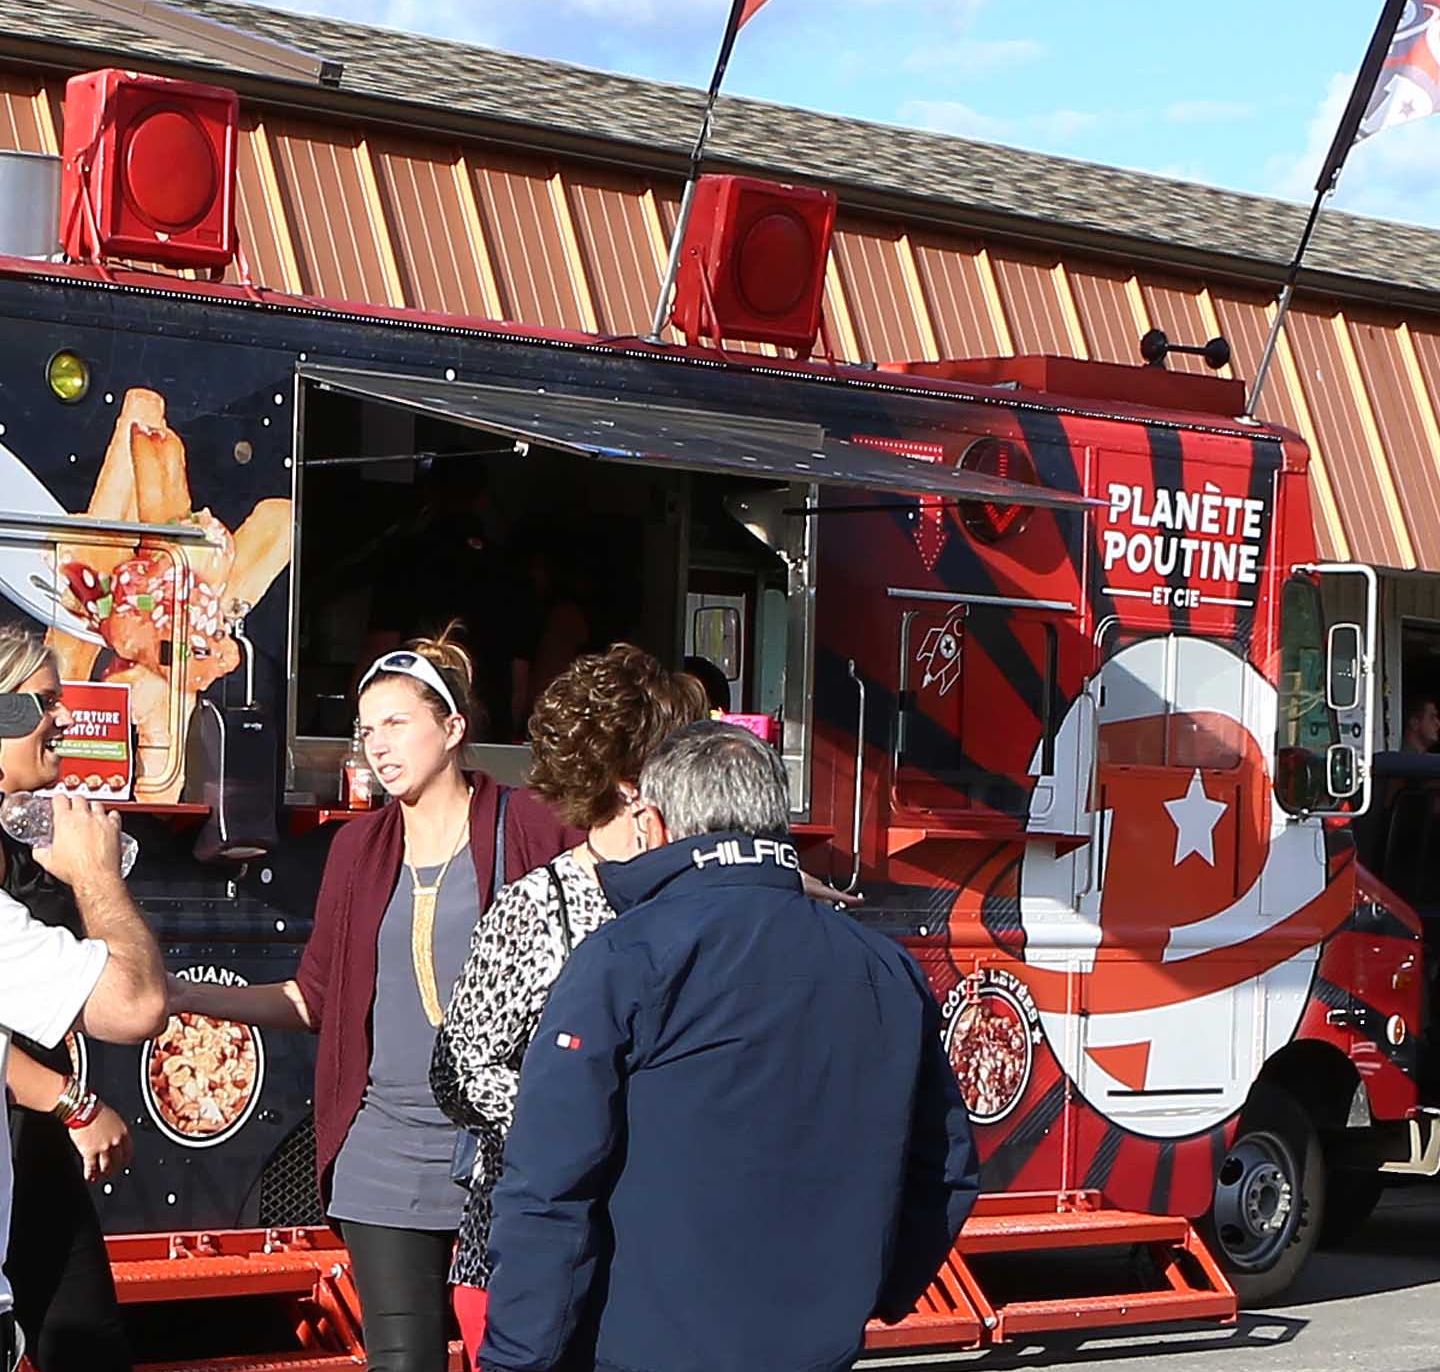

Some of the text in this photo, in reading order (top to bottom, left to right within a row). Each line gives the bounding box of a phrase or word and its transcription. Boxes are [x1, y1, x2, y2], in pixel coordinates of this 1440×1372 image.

[1108, 481, 1264, 539] PLANÈTE
[1103, 530, 1260, 584] POUTINE
[1151, 585, 1201, 608] ET CIE
